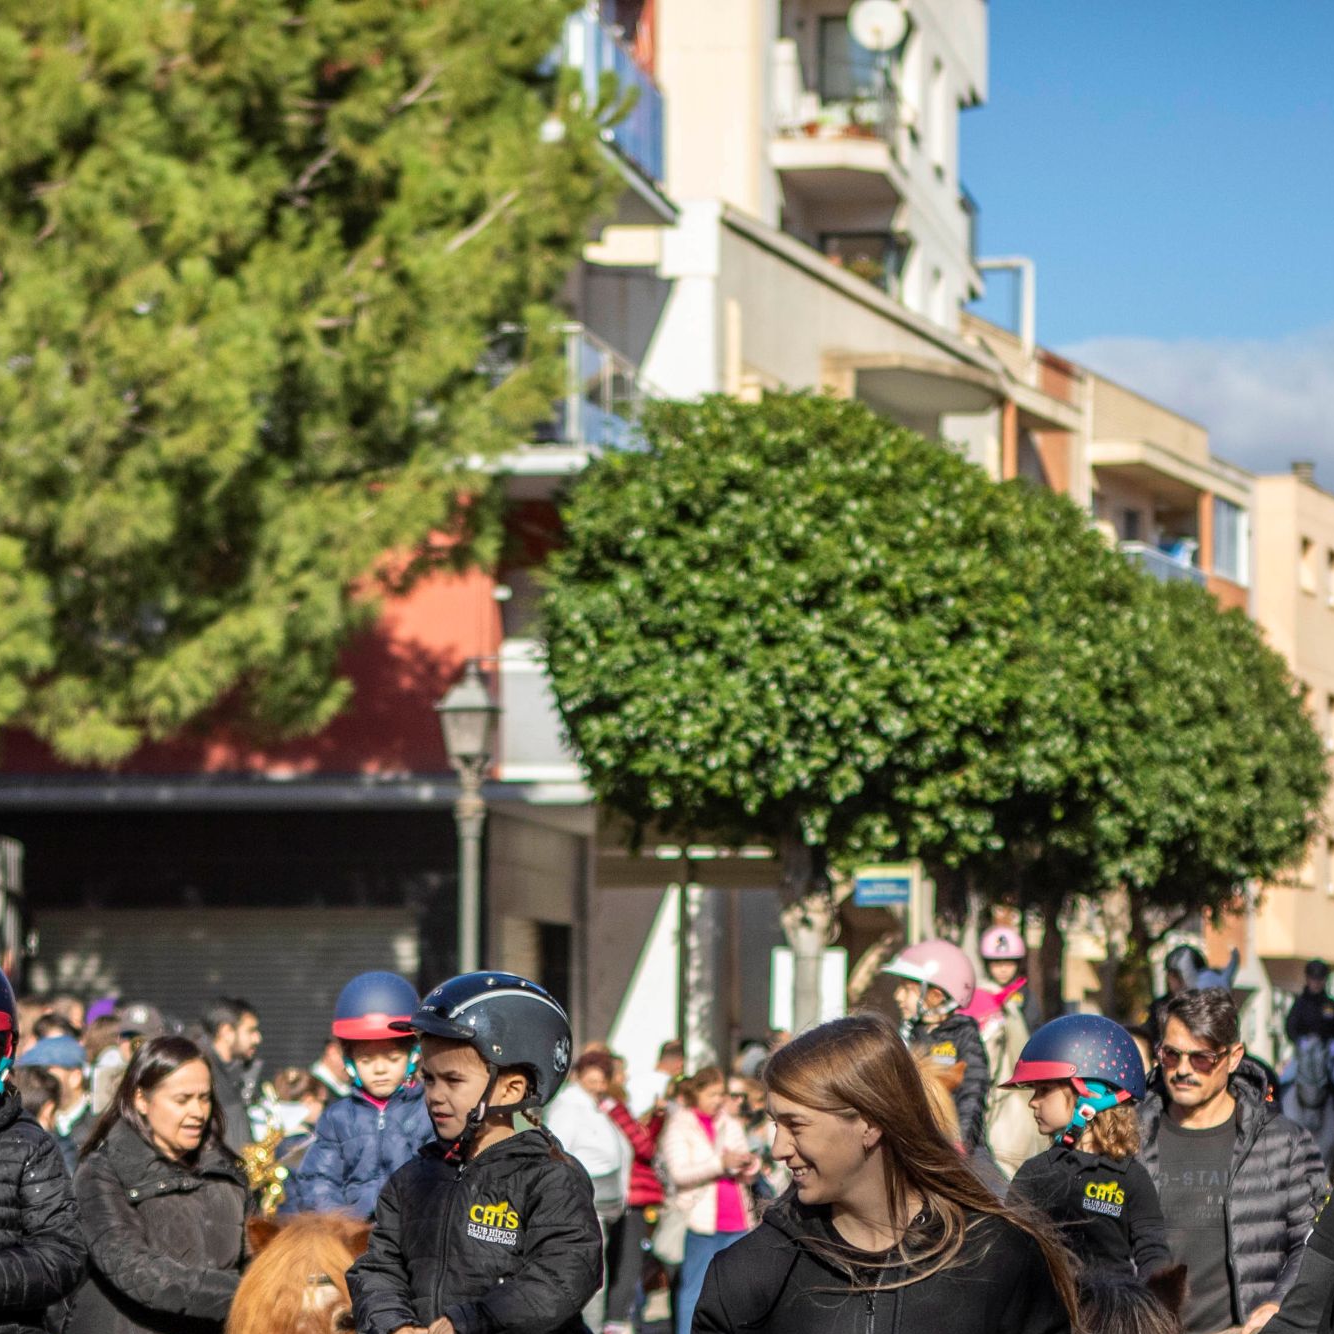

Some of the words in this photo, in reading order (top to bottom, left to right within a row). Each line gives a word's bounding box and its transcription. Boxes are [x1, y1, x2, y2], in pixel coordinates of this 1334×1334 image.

[1085, 1182, 1125, 1205] CHTS
[469, 1203, 519, 1230] CHTS
[468, 1223, 488, 1235] CLUB
[486, 1235, 517, 1245] SANTIAGO
